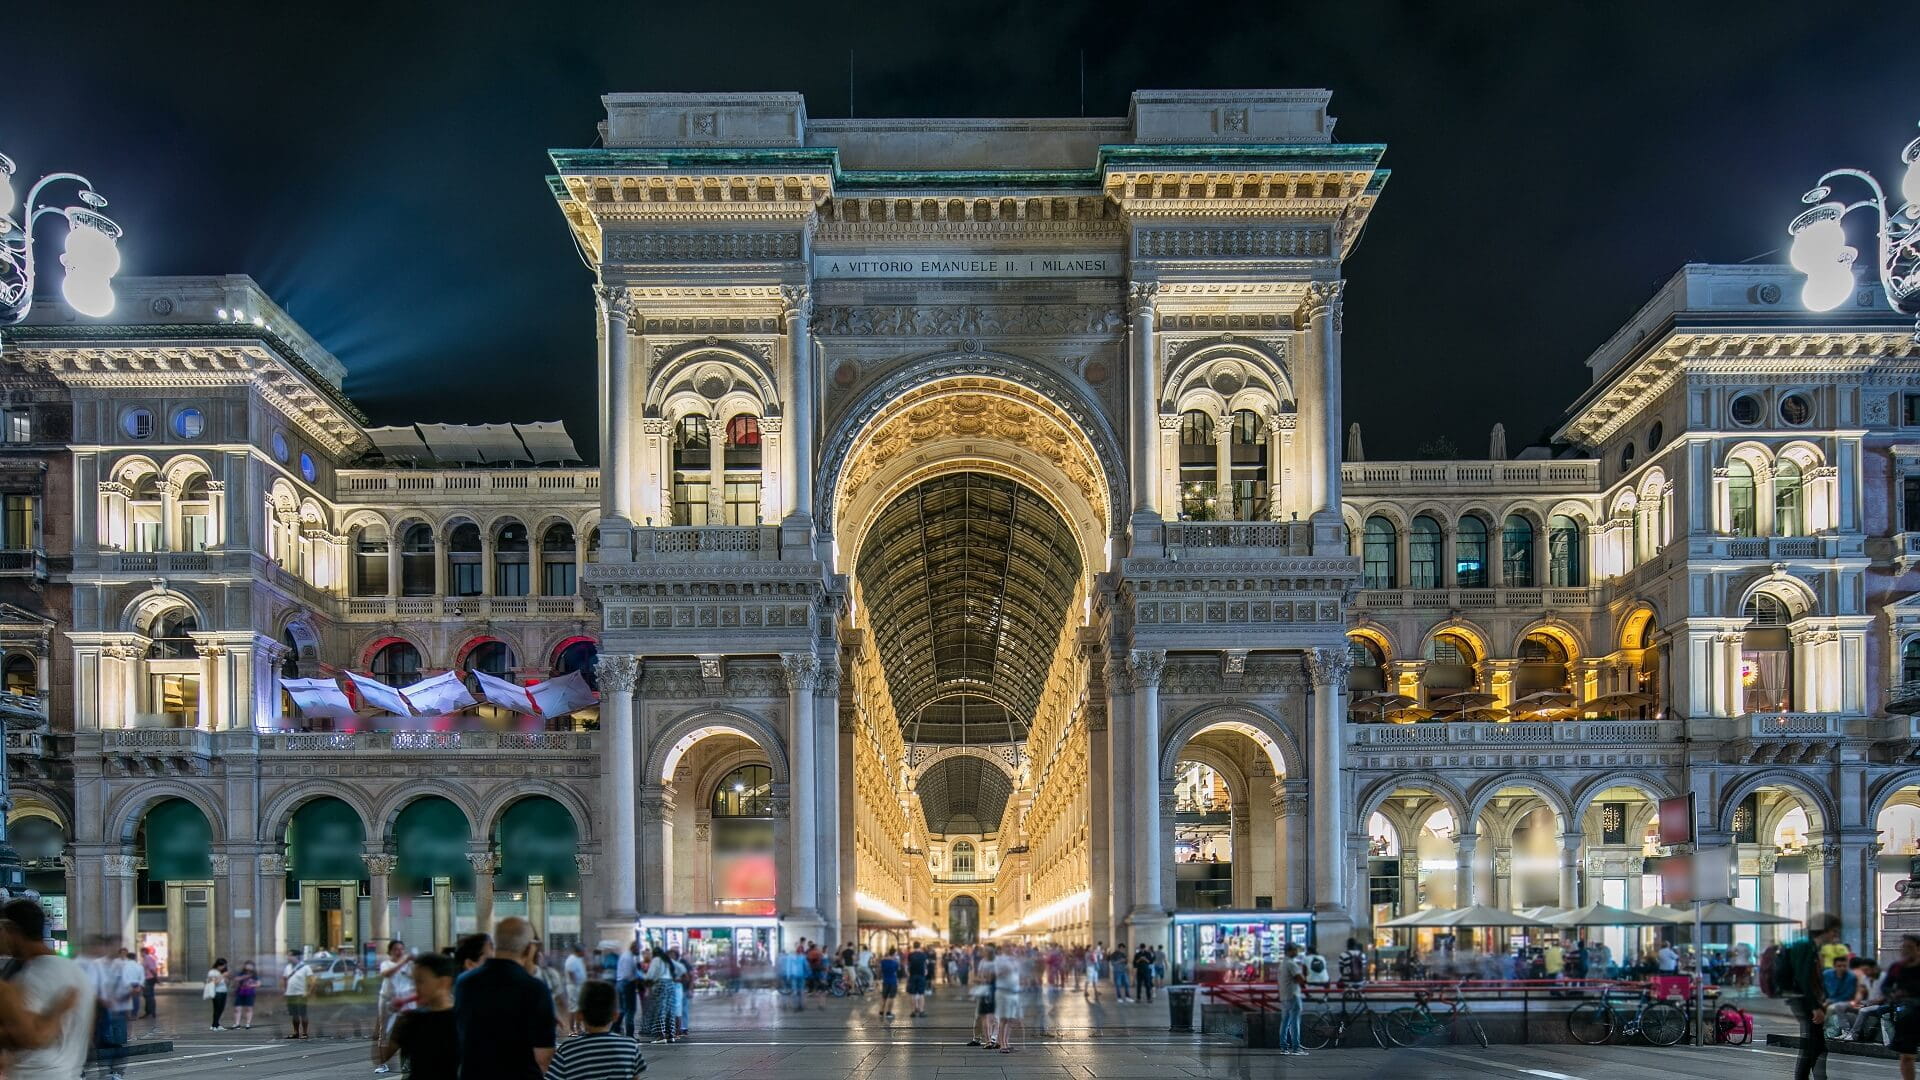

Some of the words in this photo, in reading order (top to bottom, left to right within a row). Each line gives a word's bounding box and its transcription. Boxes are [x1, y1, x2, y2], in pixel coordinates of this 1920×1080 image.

[831, 261, 840, 273] A
[849, 261, 913, 273] VITTORIO
[921, 260, 998, 272] EMANUELE
[1042, 260, 1106, 271] MILANESI
